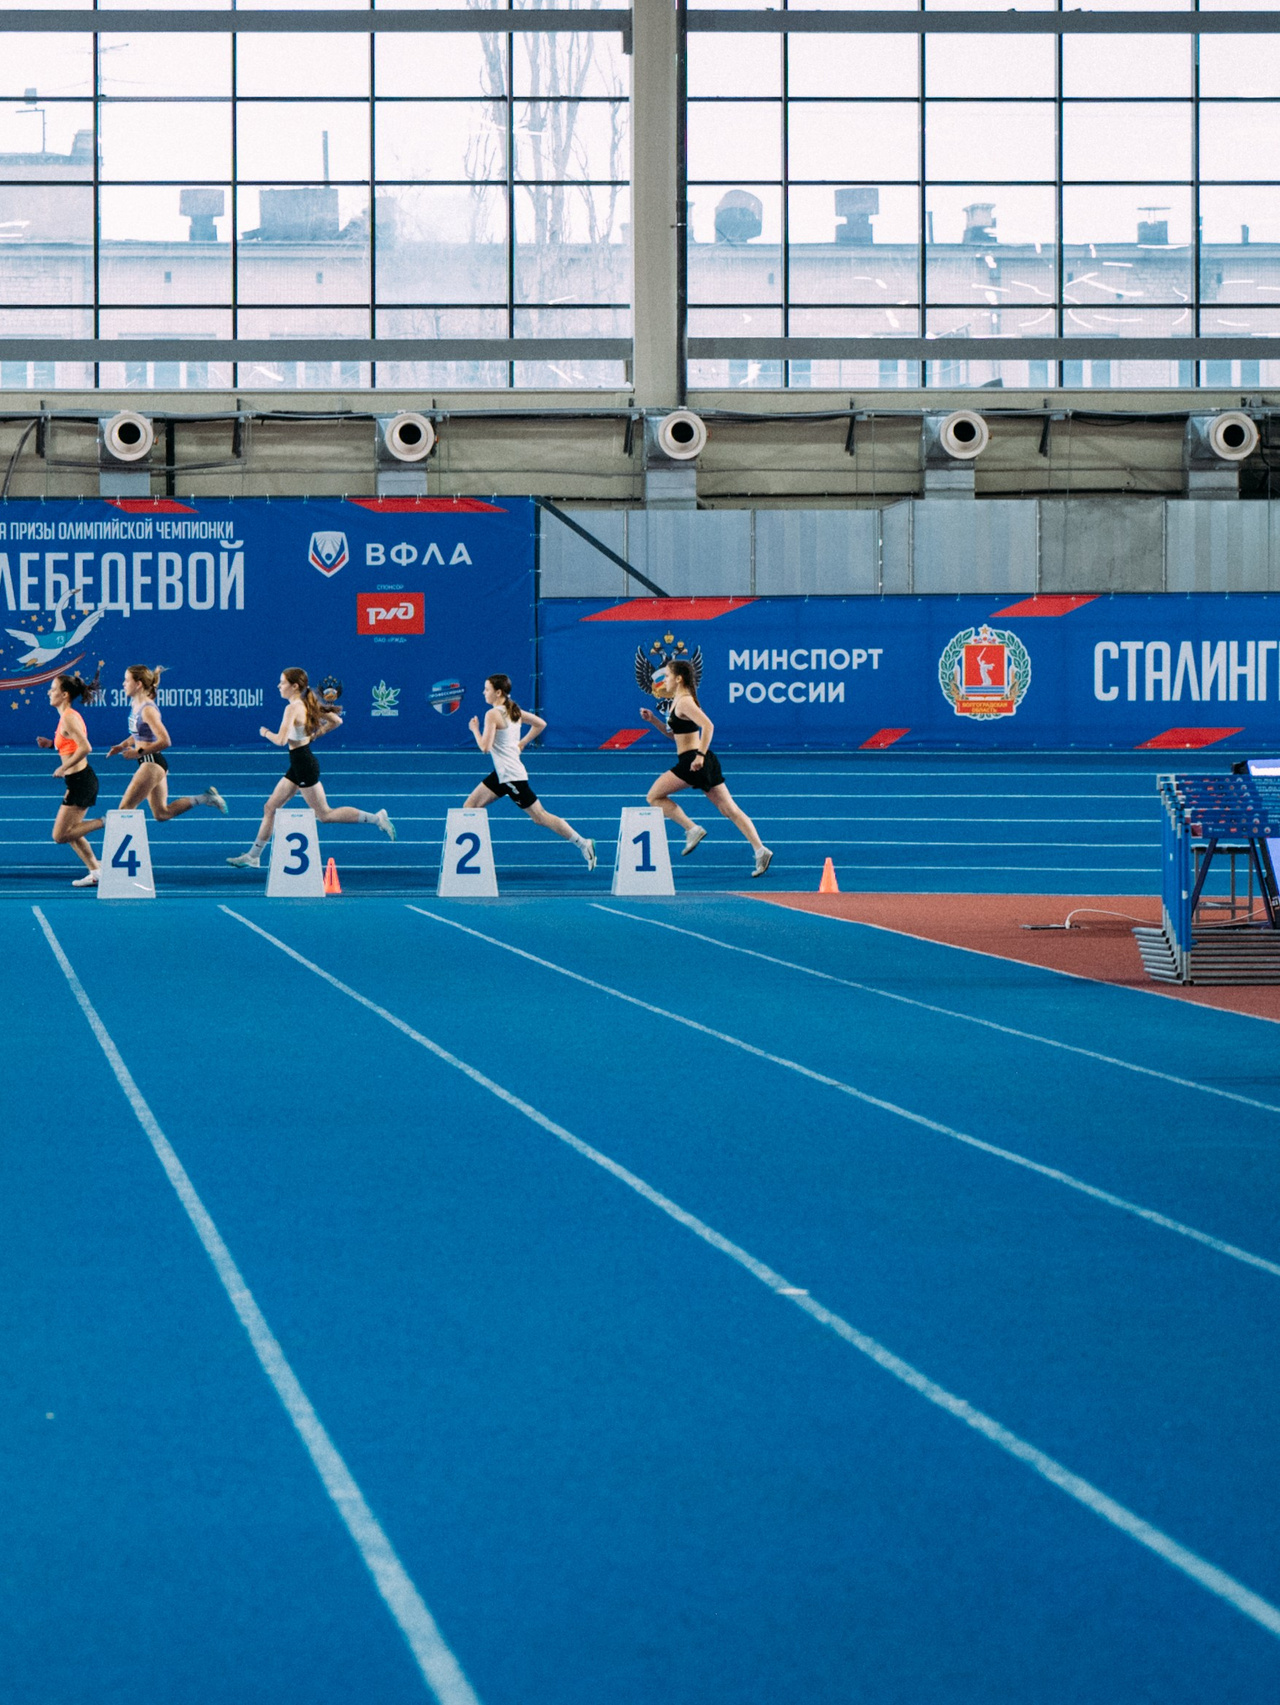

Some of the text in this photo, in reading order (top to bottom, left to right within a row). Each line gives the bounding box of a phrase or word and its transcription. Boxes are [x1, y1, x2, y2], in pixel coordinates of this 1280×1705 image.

[10, 522, 56, 540] ПРИЗЫ
[58, 518, 153, 540] ОЛИМПИЙСКОЙ
[156, 521, 234, 539] ЧЕМПИОНКИ
[366, 542, 473, 566] ВФЛА
[729, 648, 883, 670] МИНСПОРТ
[1094, 640, 1280, 701] СТАЛИНГ
[110, 689, 202, 707] ЗААЮТСЯ
[205, 689, 263, 709] ЗВЕЗДЫ!
[729, 681, 845, 703] РОССИИ
[111, 834, 141, 878] 4
[283, 832, 310, 876] 3
[455, 831, 482, 875] 2
[631, 830, 657, 873] 1
